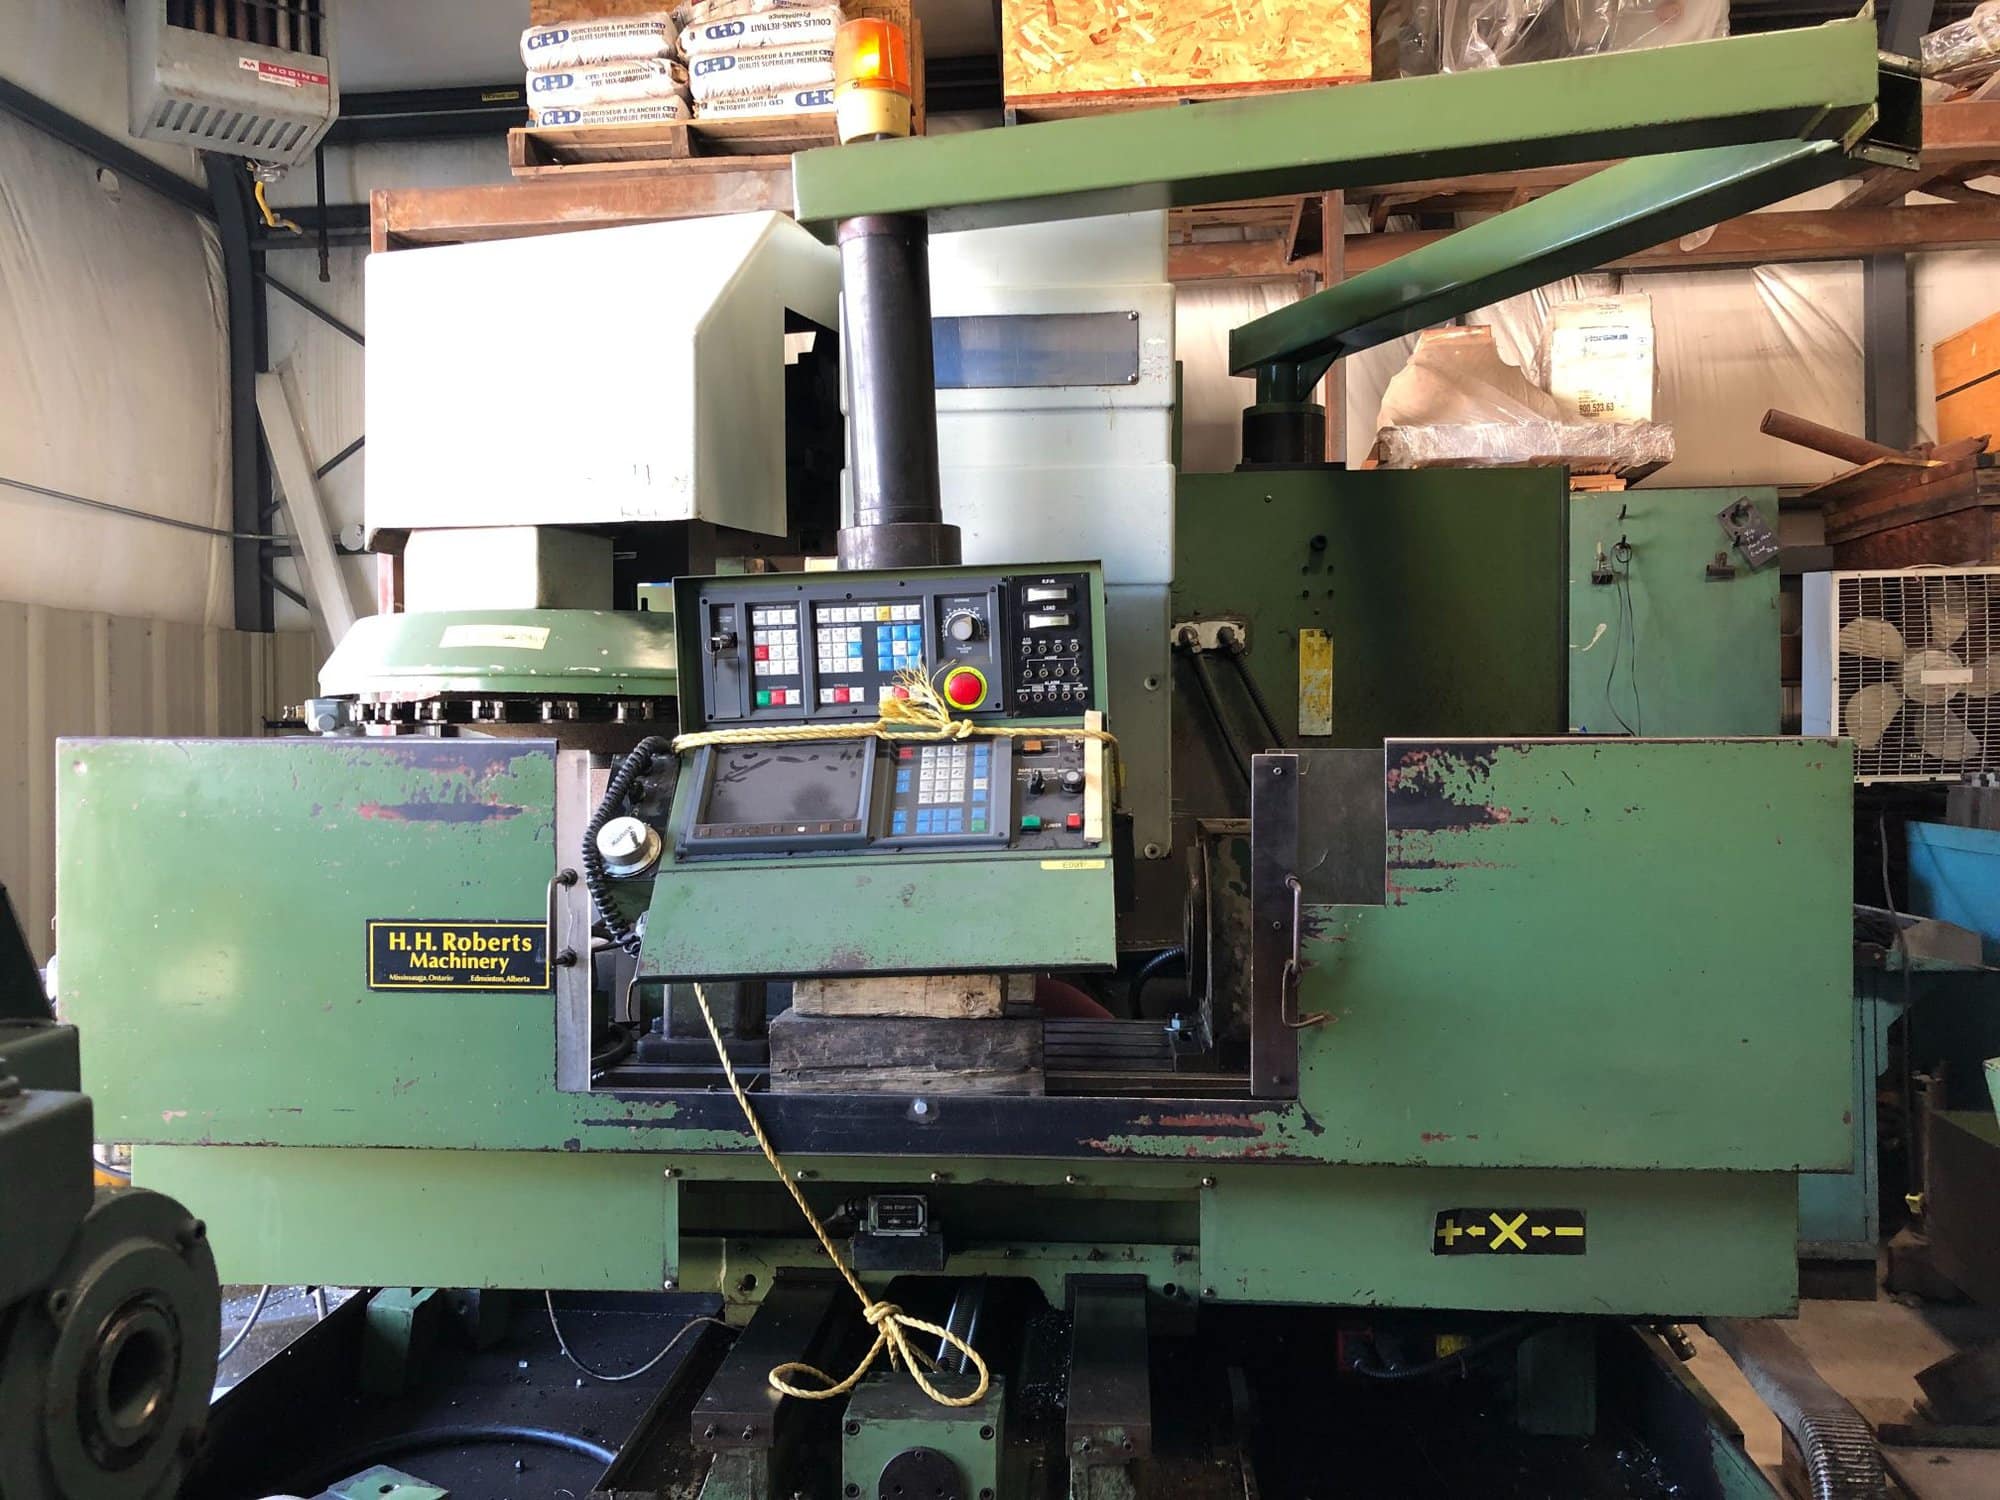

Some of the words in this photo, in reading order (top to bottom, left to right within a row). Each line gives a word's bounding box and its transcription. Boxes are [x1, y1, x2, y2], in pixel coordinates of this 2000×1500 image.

[527, 29, 569, 50] CPD
[705, 21, 745, 40] CPD
[268, 66, 319, 82] MODINE
[694, 56, 736, 77] CPD
[532, 73, 574, 92] CPD
[542, 110, 581, 126] CPD
[442, 931, 533, 952] Roberts
[409, 952, 510, 974] Machinery
